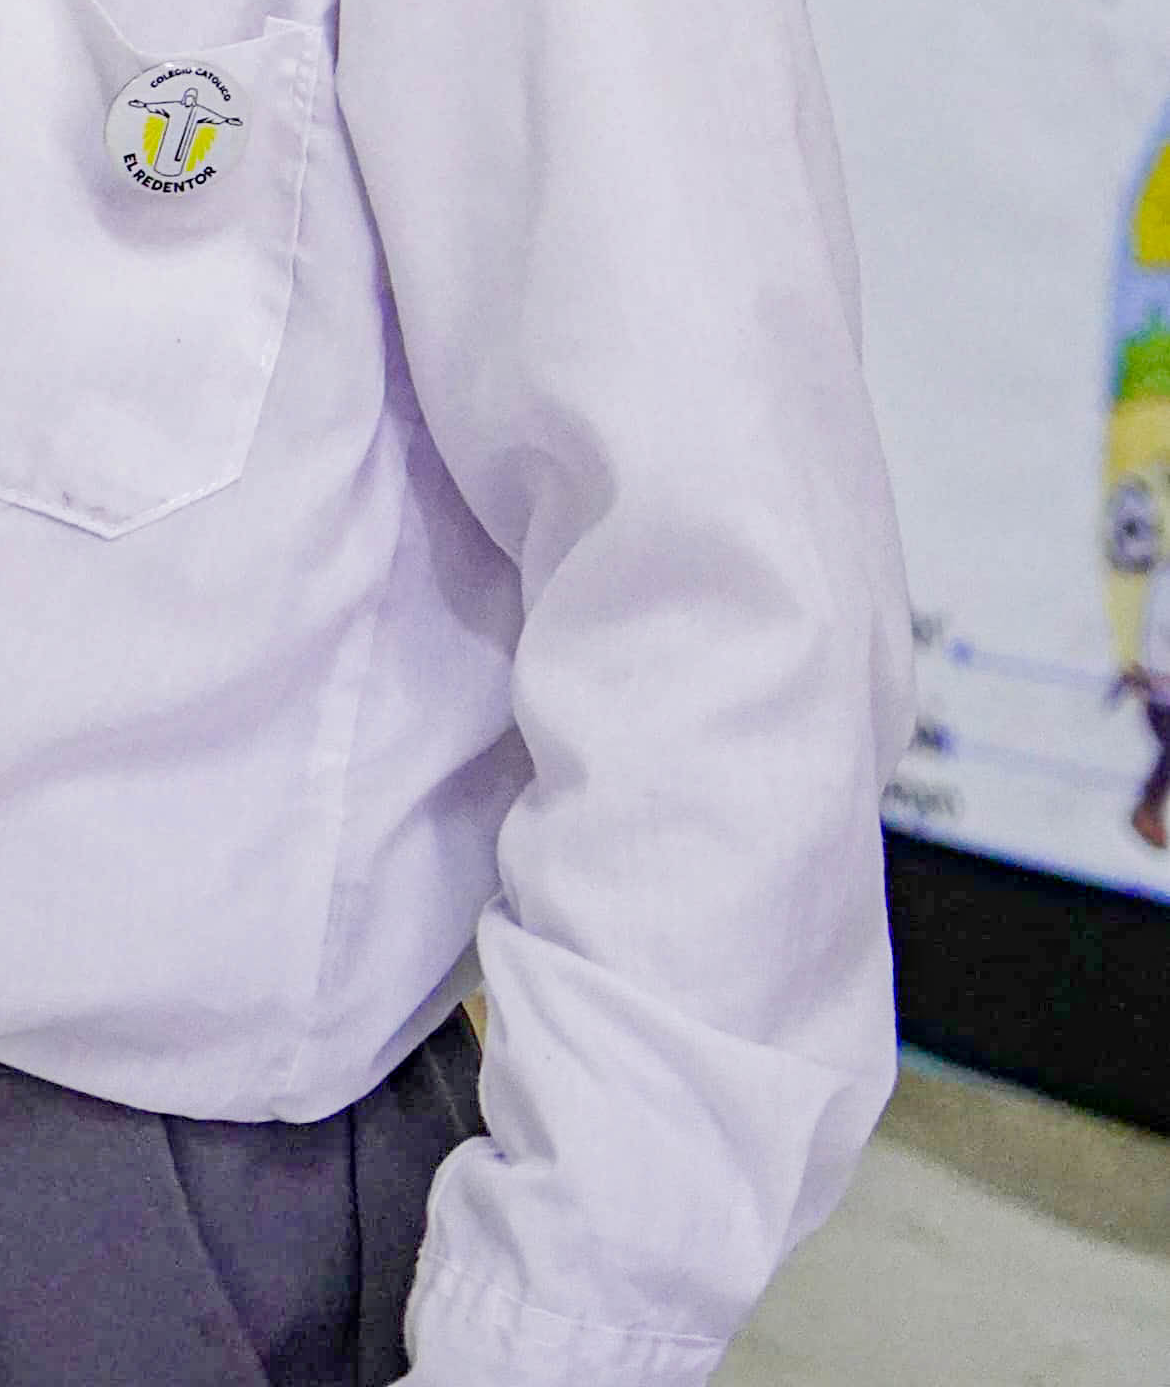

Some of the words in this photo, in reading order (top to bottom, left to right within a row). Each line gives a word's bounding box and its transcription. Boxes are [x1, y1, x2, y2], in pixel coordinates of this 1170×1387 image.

[150, 68, 193, 89] COLEGIO
[123, 153, 138, 172] EL
[133, 166, 217, 193] REDENTOR
